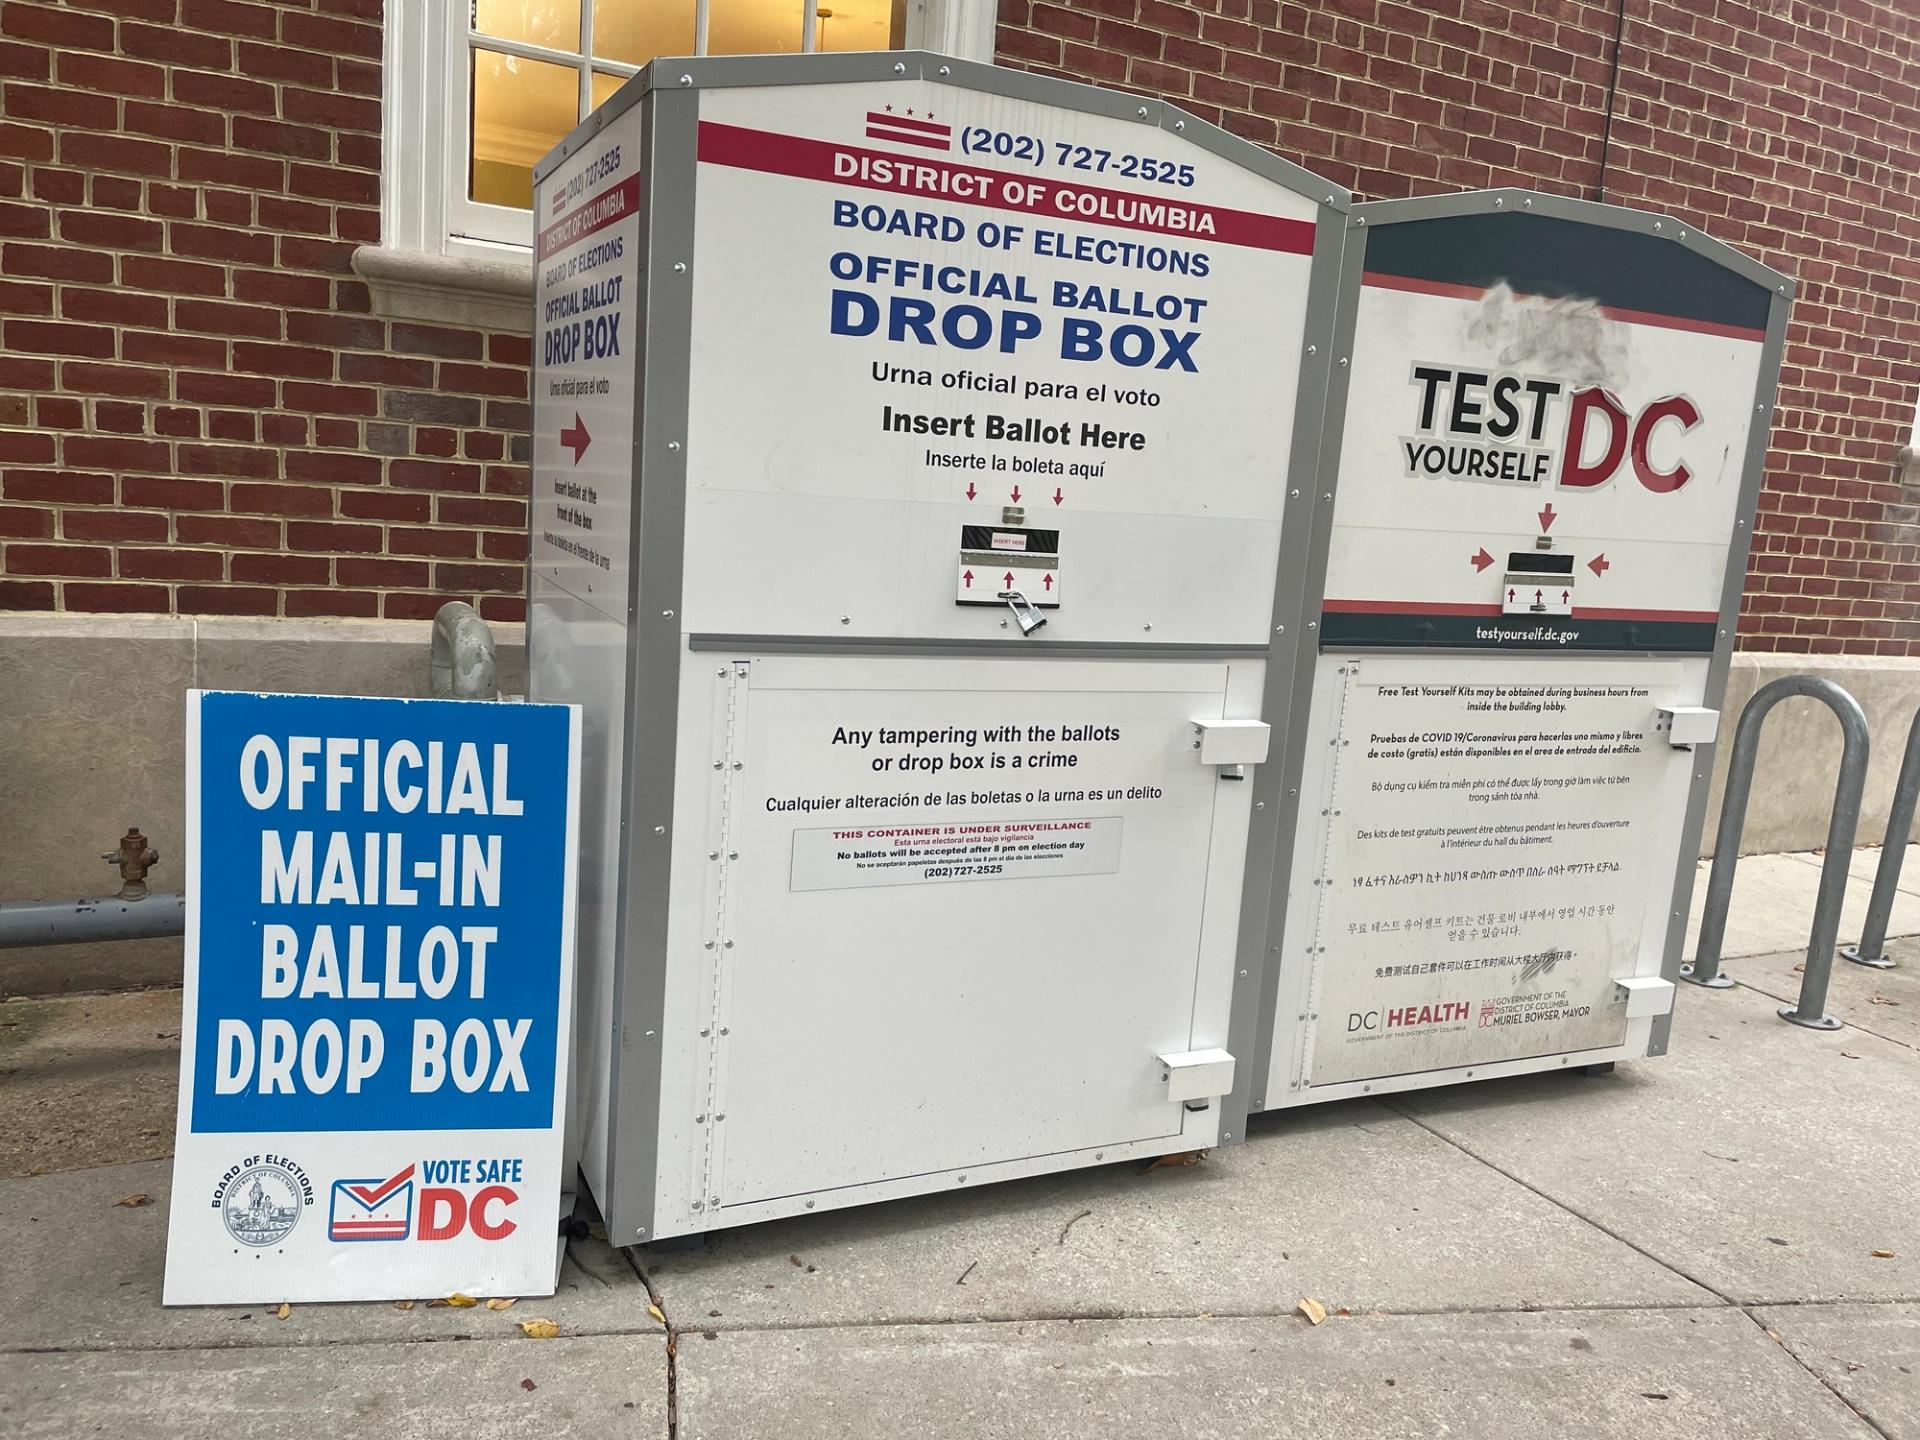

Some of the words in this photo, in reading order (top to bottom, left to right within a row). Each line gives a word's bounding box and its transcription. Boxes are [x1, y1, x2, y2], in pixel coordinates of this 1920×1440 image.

[566, 178, 584, 206] (202)
[585, 145, 621, 188] 727-2525
[962, 127, 1044, 166] (202)
[1056, 143, 1194, 186] 727-2525
[834, 152, 993, 198] DISTRICT
[1003, 182, 1046, 206] OF
[1055, 190, 1216, 234] COLUMBIA
[546, 220, 571, 252] DISTRICT
[572, 216, 582, 236] OF
[582, 190, 624, 230] COLUMBIA
[834, 200, 965, 242] BOARD
[977, 223, 1024, 250] OF
[1034, 230, 1209, 277] ELECTIONS
[546, 264, 566, 288] BOARD
[568, 258, 577, 277] OF
[580, 236, 623, 272] ELECTIONS
[546, 293, 580, 323] OFFICIAL
[583, 276, 622, 310] BALLOT
[830, 252, 1037, 303] OFFICIAL
[1053, 281, 1207, 323] BALLOT
[545, 323, 580, 366] DROP
[584, 312, 620, 360] BOX
[830, 289, 1042, 354] DROP
[1061, 318, 1201, 373] BOX
[873, 362, 931, 386] Urna
[942, 370, 1016, 394] oficial
[1025, 382, 1077, 399] para
[1086, 384, 1106, 402] el
[1114, 389, 1160, 406] voto
[883, 406, 975, 438] Insert
[986, 415, 1070, 445] Ballot
[1081, 423, 1145, 450] Here
[1414, 367, 1560, 440] TEST
[1560, 386, 1700, 494] DC
[926, 450, 986, 469] Inserte
[992, 454, 1006, 470] la
[1013, 456, 1063, 474] boleta
[1070, 461, 1106, 480] aquí
[1406, 443, 1550, 482] YOURSELF
[1476, 626, 1580, 644] testyourself.dc.gov
[1378, 686, 1398, 696] Free
[1401, 686, 1418, 696] Test
[1422, 686, 1457, 696] Yourself
[1458, 687, 1474, 696] Kits
[1476, 690, 1494, 698] may
[1496, 687, 1506, 696] be
[1508, 687, 1545, 696] obtained
[1546, 687, 1572, 698] during
[1574, 687, 1606, 696] business
[1608, 687, 1628, 696] hours
[1631, 687, 1648, 696] from
[1467, 701, 1491, 710] inside
[1494, 702, 1507, 711] the
[1509, 702, 1541, 713] building
[1543, 701, 1566, 712] lobby.
[832, 727, 872, 748] Any
[879, 726, 976, 747] tampering
[984, 726, 1021, 742] with
[1028, 726, 1055, 742] the
[1062, 725, 1119, 741] ballots
[1371, 733, 1406, 743] Pruebas
[1409, 733, 1419, 742] de
[1422, 733, 1452, 742] COVID
[1455, 732, 1516, 743] 19/Coronavirus
[1518, 735, 1537, 744] para
[1539, 732, 1572, 740] hacerlas
[1590, 732, 1614, 740] mismo
[1616, 734, 1621, 742] y
[1622, 730, 1643, 739] libres
[240, 734, 524, 816] OFFICIAL
[872, 758, 893, 771] or
[899, 754, 943, 774] drop
[950, 753, 984, 769] box
[991, 752, 1005, 768] is
[1012, 756, 1022, 768] a
[1028, 751, 1077, 767] crime
[766, 796, 841, 813] Cualquier
[846, 792, 919, 808] alteración
[924, 793, 941, 806] de
[946, 792, 966, 805] las
[971, 791, 1021, 804] boletas
[1026, 793, 1034, 802] o
[1038, 789, 1049, 802] la
[1055, 791, 1084, 801] urna
[1088, 791, 1102, 800] es
[1108, 790, 1122, 800] un
[1127, 786, 1162, 799] delito
[833, 831, 863, 839] THIS
[868, 828, 940, 837] CONTAINER
[960, 826, 1000, 834] UNDER
[1004, 822, 1091, 832] SURVEILLANCE
[838, 852, 851, 860] No
[924, 846, 967, 856] accepted
[1032, 842, 1066, 850] election
[1069, 842, 1085, 850] day
[1000, 834, 1034, 843] vigilancia
[261, 830, 502, 906] MAIL-IN
[1470, 928, 1479, 939] 수
[261, 924, 498, 999] BALLOT
[1348, 1011, 1378, 1032] DC
[1387, 1002, 1470, 1028] HEALTH
[1493, 1014, 1523, 1026] MURIEL
[1525, 1010, 1561, 1023] BOWSER,
[1562, 1006, 1590, 1018] MAYOR
[1495, 1004, 1523, 1015] DISTRICT
[1525, 1003, 1534, 1012] OF
[1535, 1000, 1569, 1010] COLUMBIA
[1496, 993, 1542, 1005] GOVERNMENT
[1544, 992, 1553, 1000] OF
[1555, 991, 1567, 999] THE
[216, 1018, 384, 1094] DROP
[410, 1018, 533, 1094] BOX
[212, 1165, 240, 1208] BOARD
[244, 1155, 260, 1167] OF
[266, 1154, 314, 1206] ELECTIONS
[423, 1160, 472, 1184] VOTE
[476, 1159, 522, 1183] SAFE
[417, 1186, 519, 1241] DC
